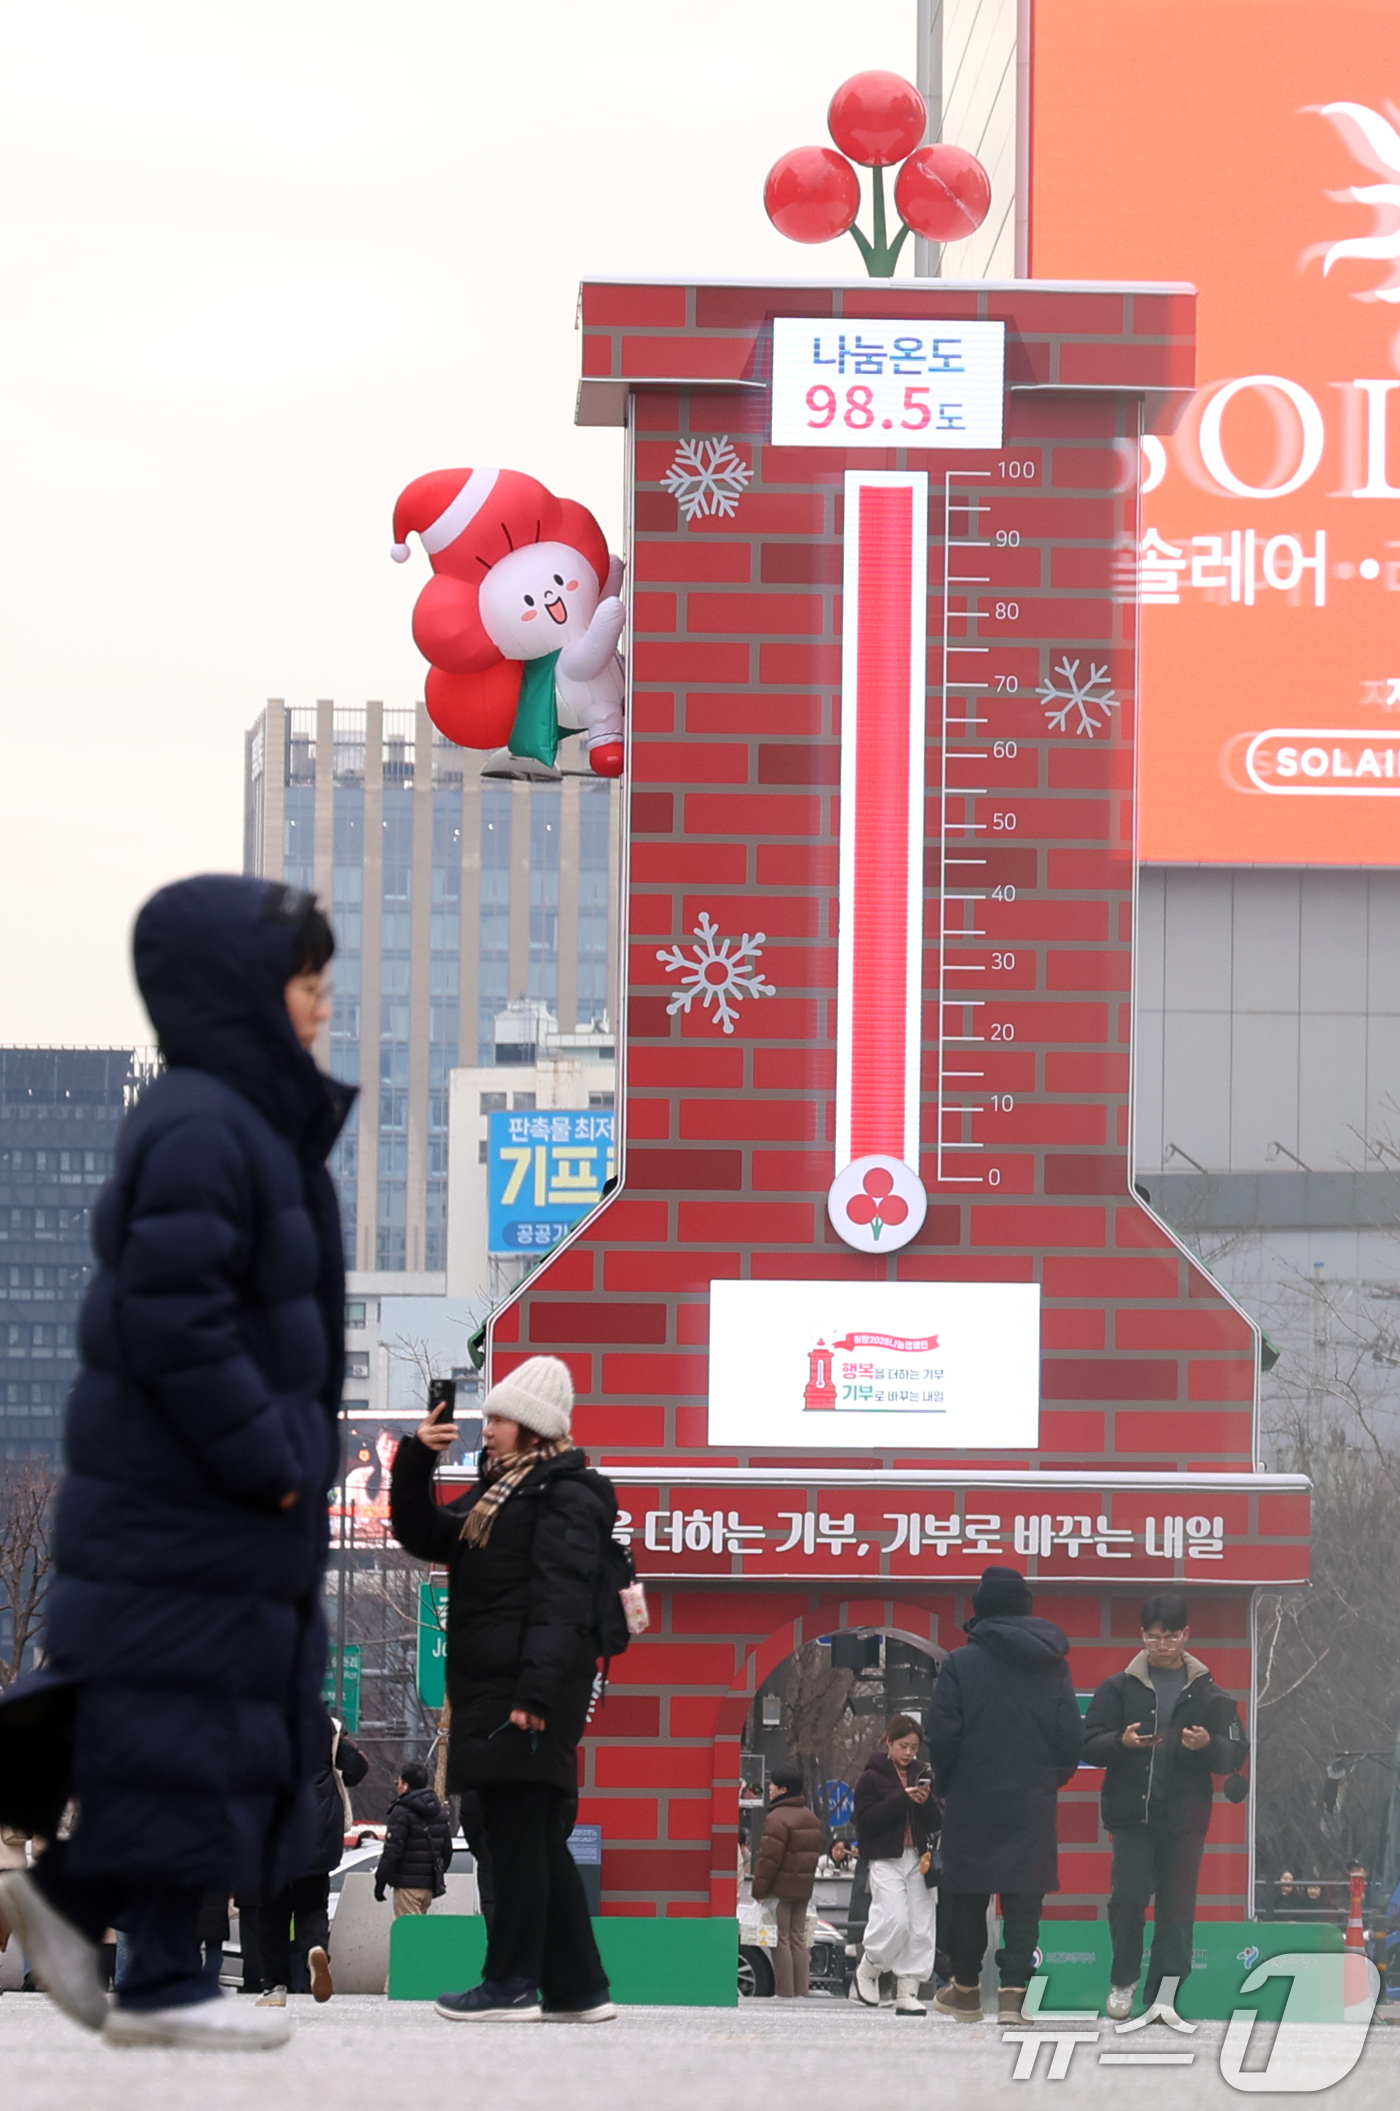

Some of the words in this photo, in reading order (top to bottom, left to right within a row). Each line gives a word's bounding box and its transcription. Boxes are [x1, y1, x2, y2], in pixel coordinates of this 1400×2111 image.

[812, 335, 966, 375] 나눔온도
[998, 461, 1035, 479] 100
[995, 530, 1020, 548] 90
[1137, 528, 1327, 607] 솔레어
[995, 602, 1019, 620] 80
[994, 675, 1018, 693] 70
[993, 741, 1018, 759] 60
[1276, 747, 1400, 778] SOLAI
[992, 813, 1017, 831] 50
[991, 885, 1016, 902] 40
[991, 952, 1016, 970] 30
[990, 1023, 1015, 1041] 20
[991, 1095, 1014, 1112] 10
[508, 1116, 572, 1142] 판촉물
[988, 1168, 1001, 1186] 0
[841, 1362, 885, 1380] 행복을
[888, 1368, 920, 1380] 더하는
[923, 1369, 945, 1380] 기부
[841, 1384, 885, 1402] 기부로
[888, 1391, 920, 1402] 바꾸는
[922, 1391, 945, 1402] 내일
[644, 1508, 767, 1555] 더하는
[775, 1511, 870, 1557] 기부,
[880, 1512, 1003, 1557] 기부로
[1013, 1513, 1135, 1559] 바꾸는
[1144, 1515, 1225, 1560] 내일
